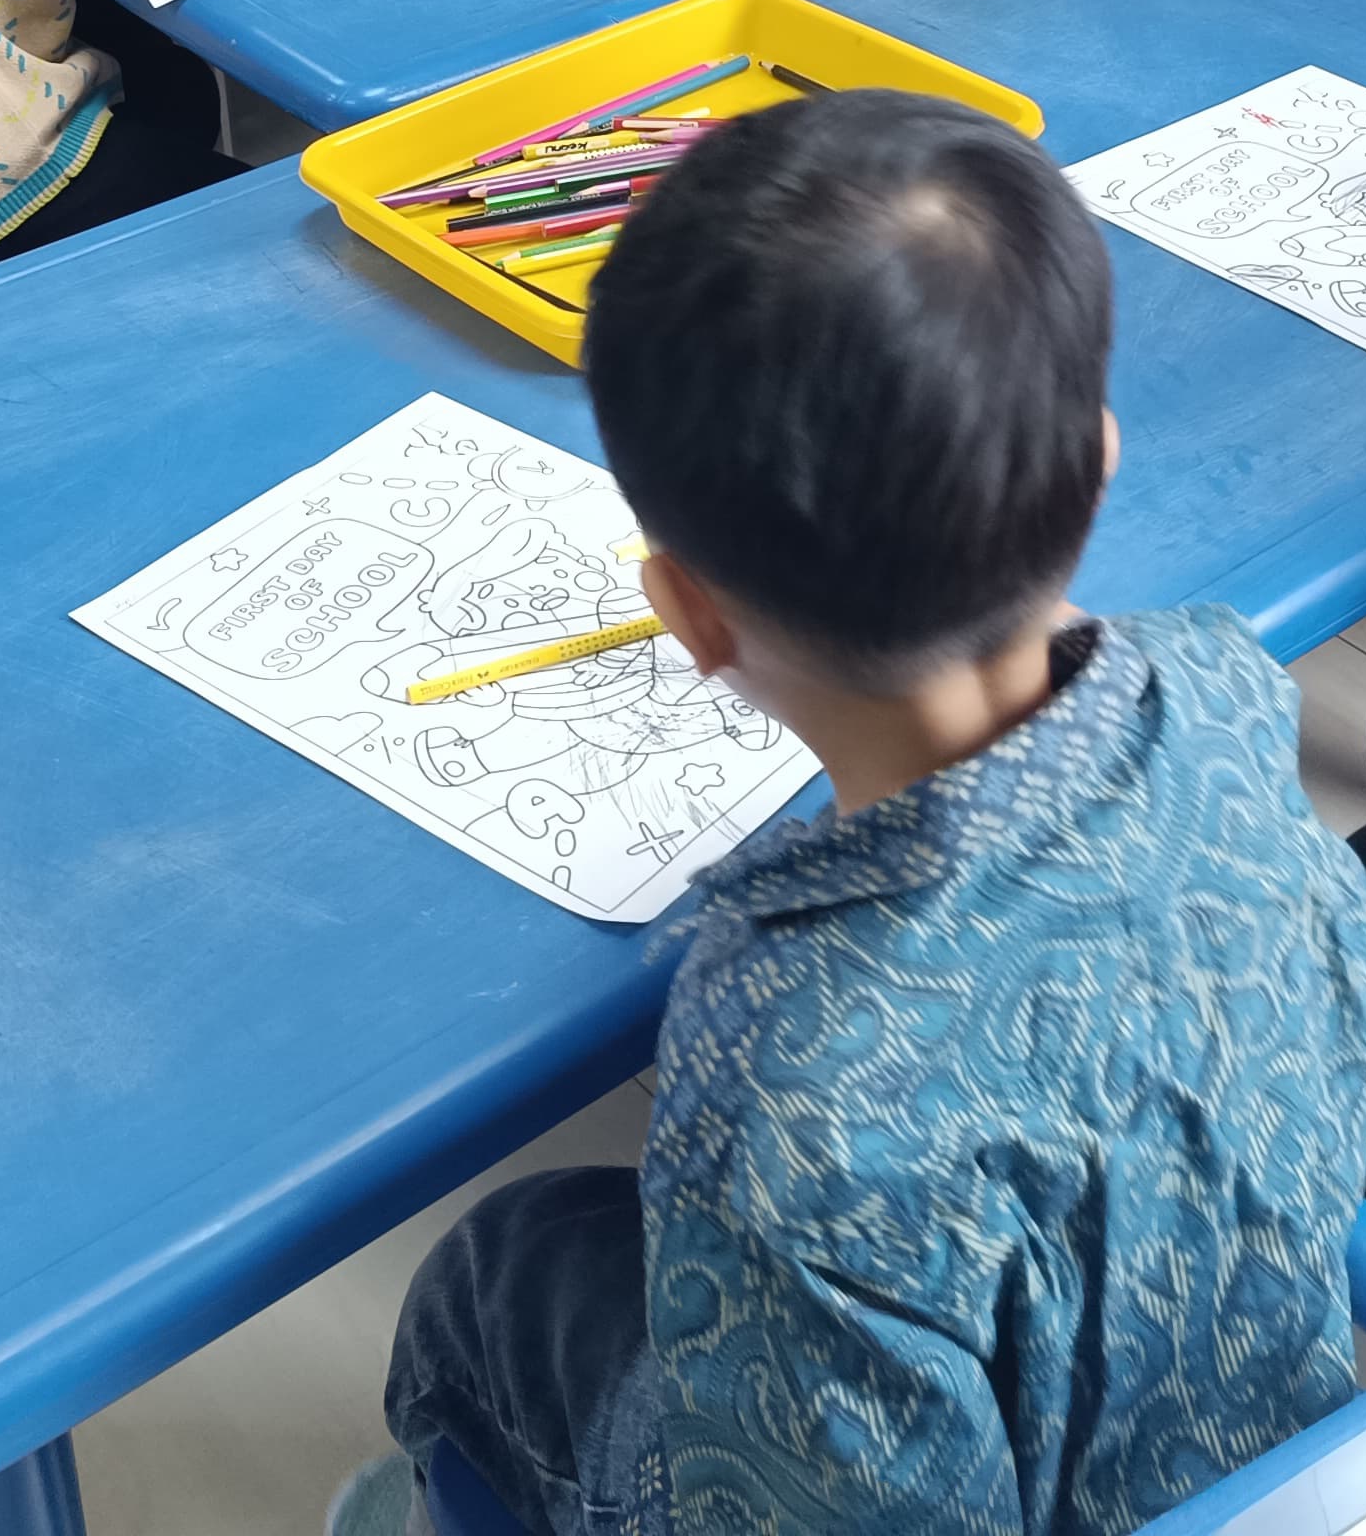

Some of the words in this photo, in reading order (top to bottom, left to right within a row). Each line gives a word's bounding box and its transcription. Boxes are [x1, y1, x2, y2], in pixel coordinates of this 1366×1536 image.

[1150, 173, 1212, 211] FIRST
[1206, 149, 1251, 175] DAY
[1197, 166, 1316, 234] SCHOOL
[1209, 177, 1240, 197] OF
[209, 575, 290, 641] FIRST
[285, 531, 342, 576] DAY
[262, 552, 418, 672] SCHOOL
[285, 578, 323, 610] OF
